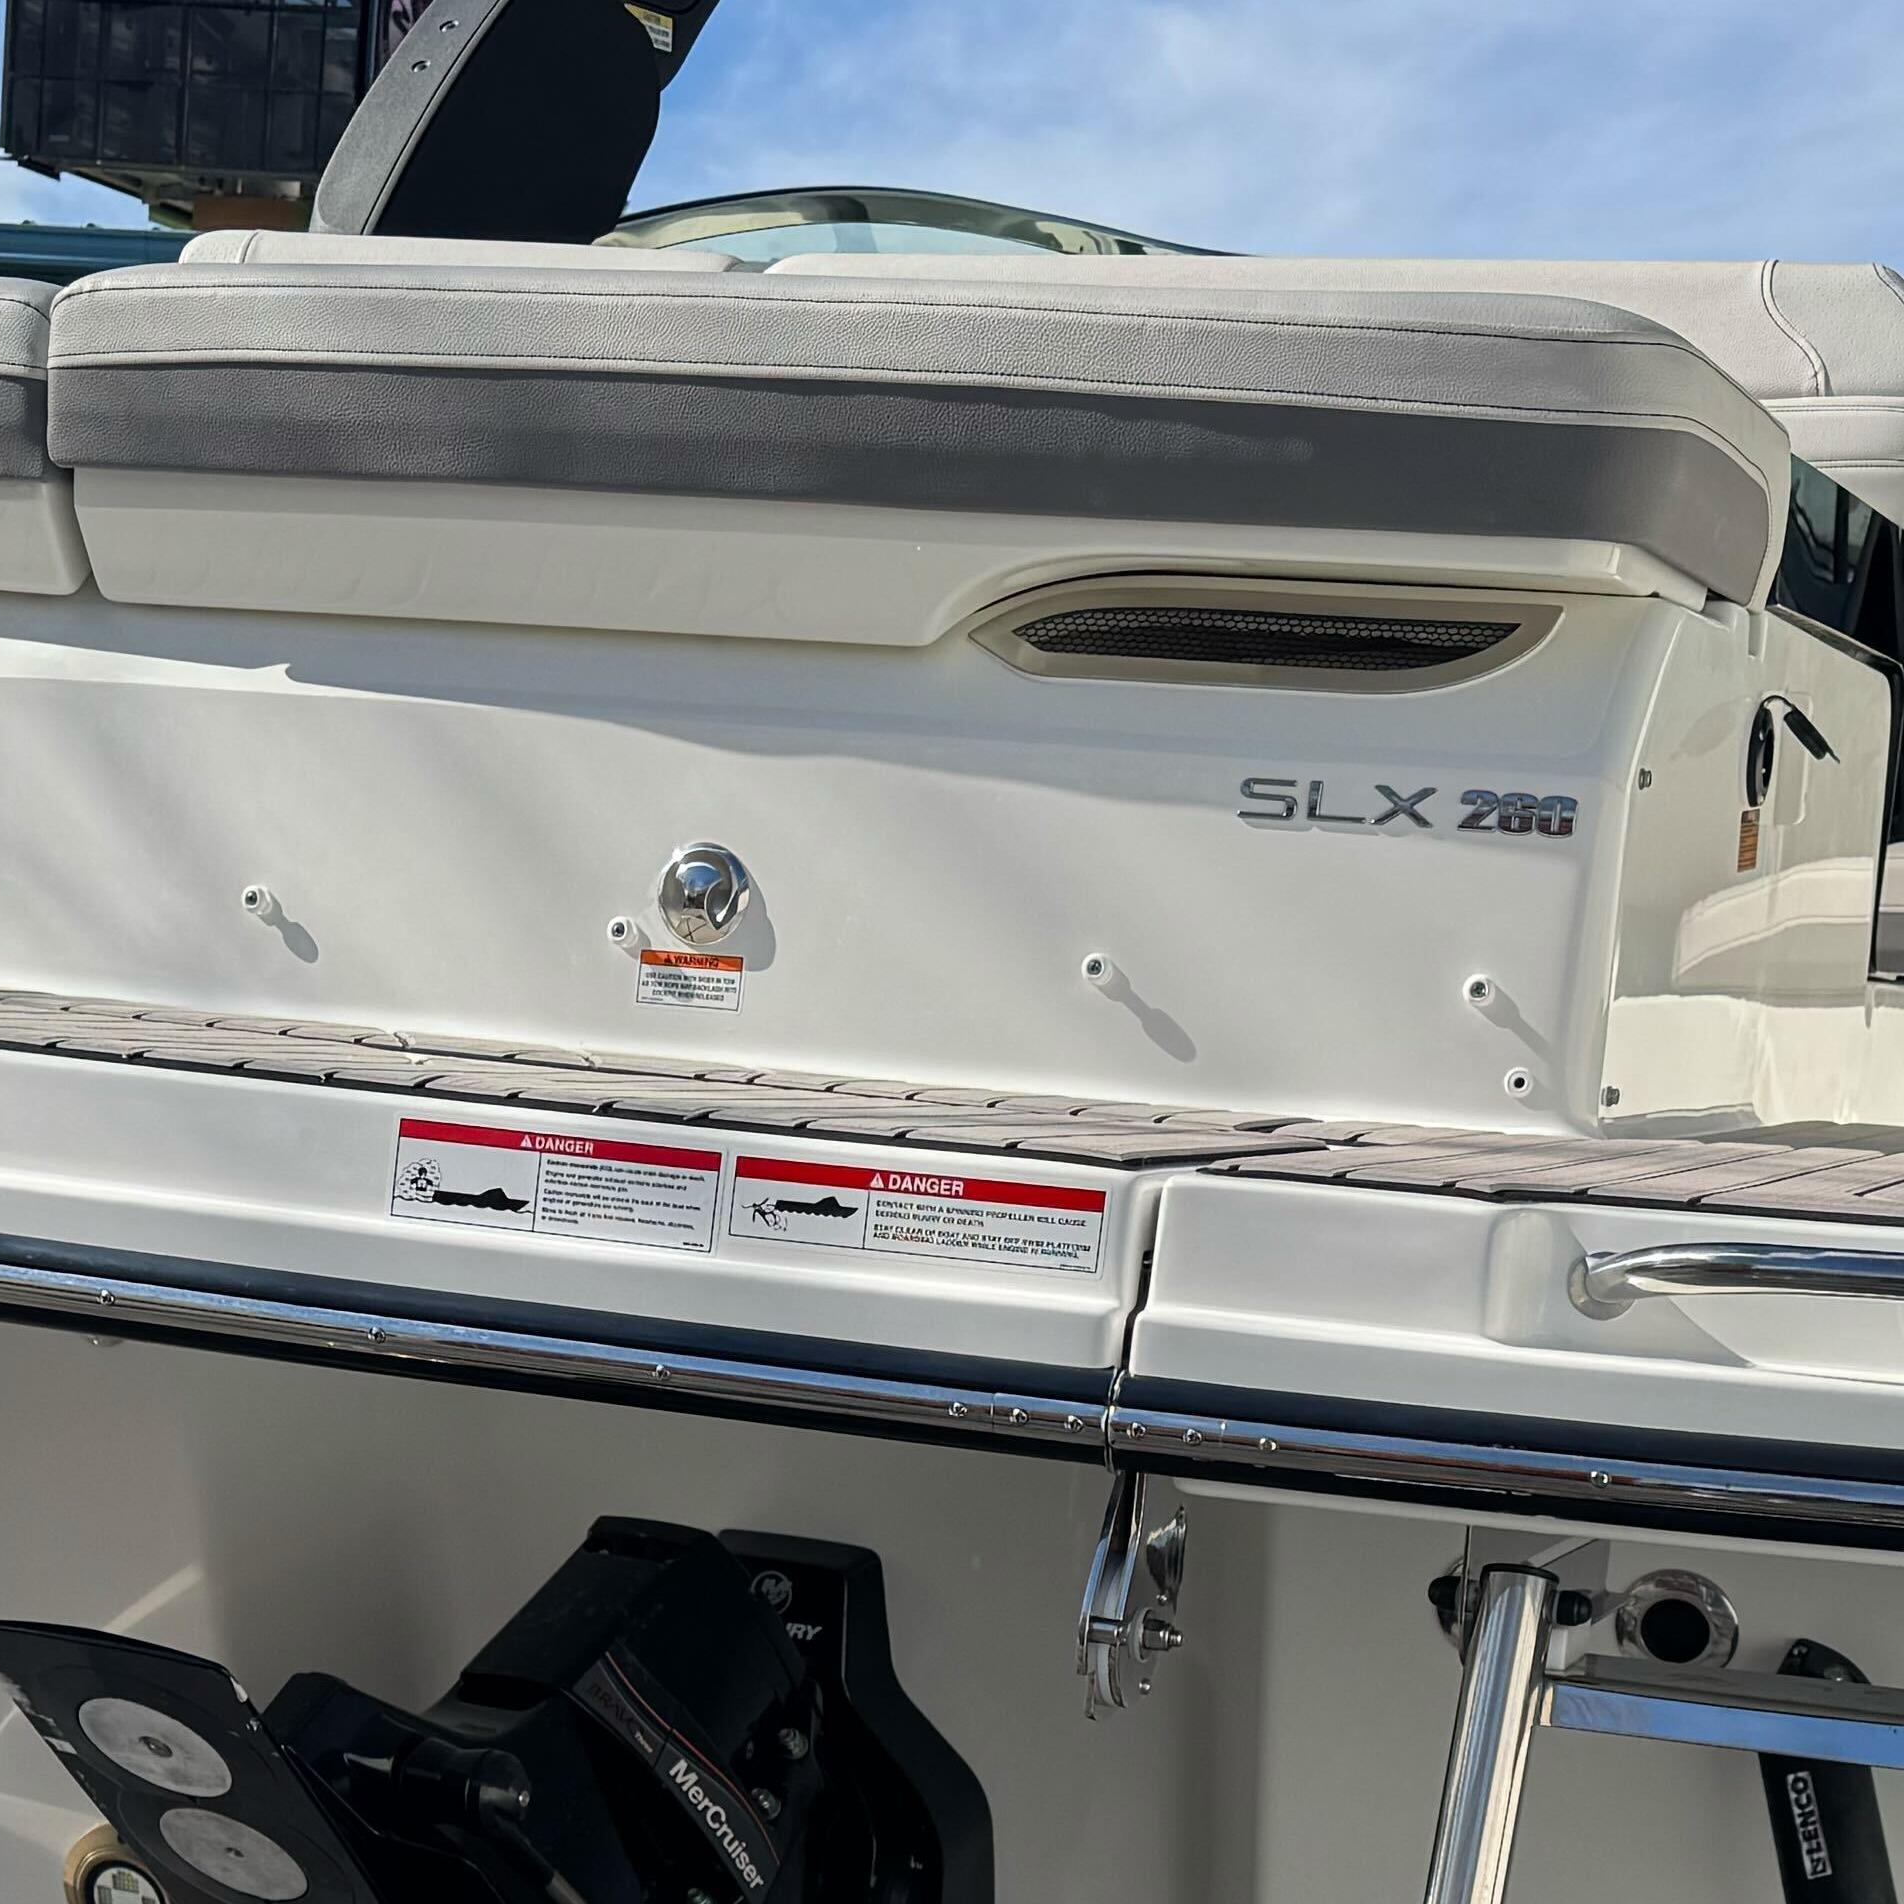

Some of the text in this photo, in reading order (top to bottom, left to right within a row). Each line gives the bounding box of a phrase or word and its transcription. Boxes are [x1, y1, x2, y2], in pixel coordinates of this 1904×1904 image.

[1237, 777, 1579, 839] SLX 260
[535, 1136, 594, 1155] DANGER
[888, 1175, 964, 1196] DANGER
[668, 1758, 765, 1890] MerCruiser
[1791, 1776, 1824, 1855] LENCO
